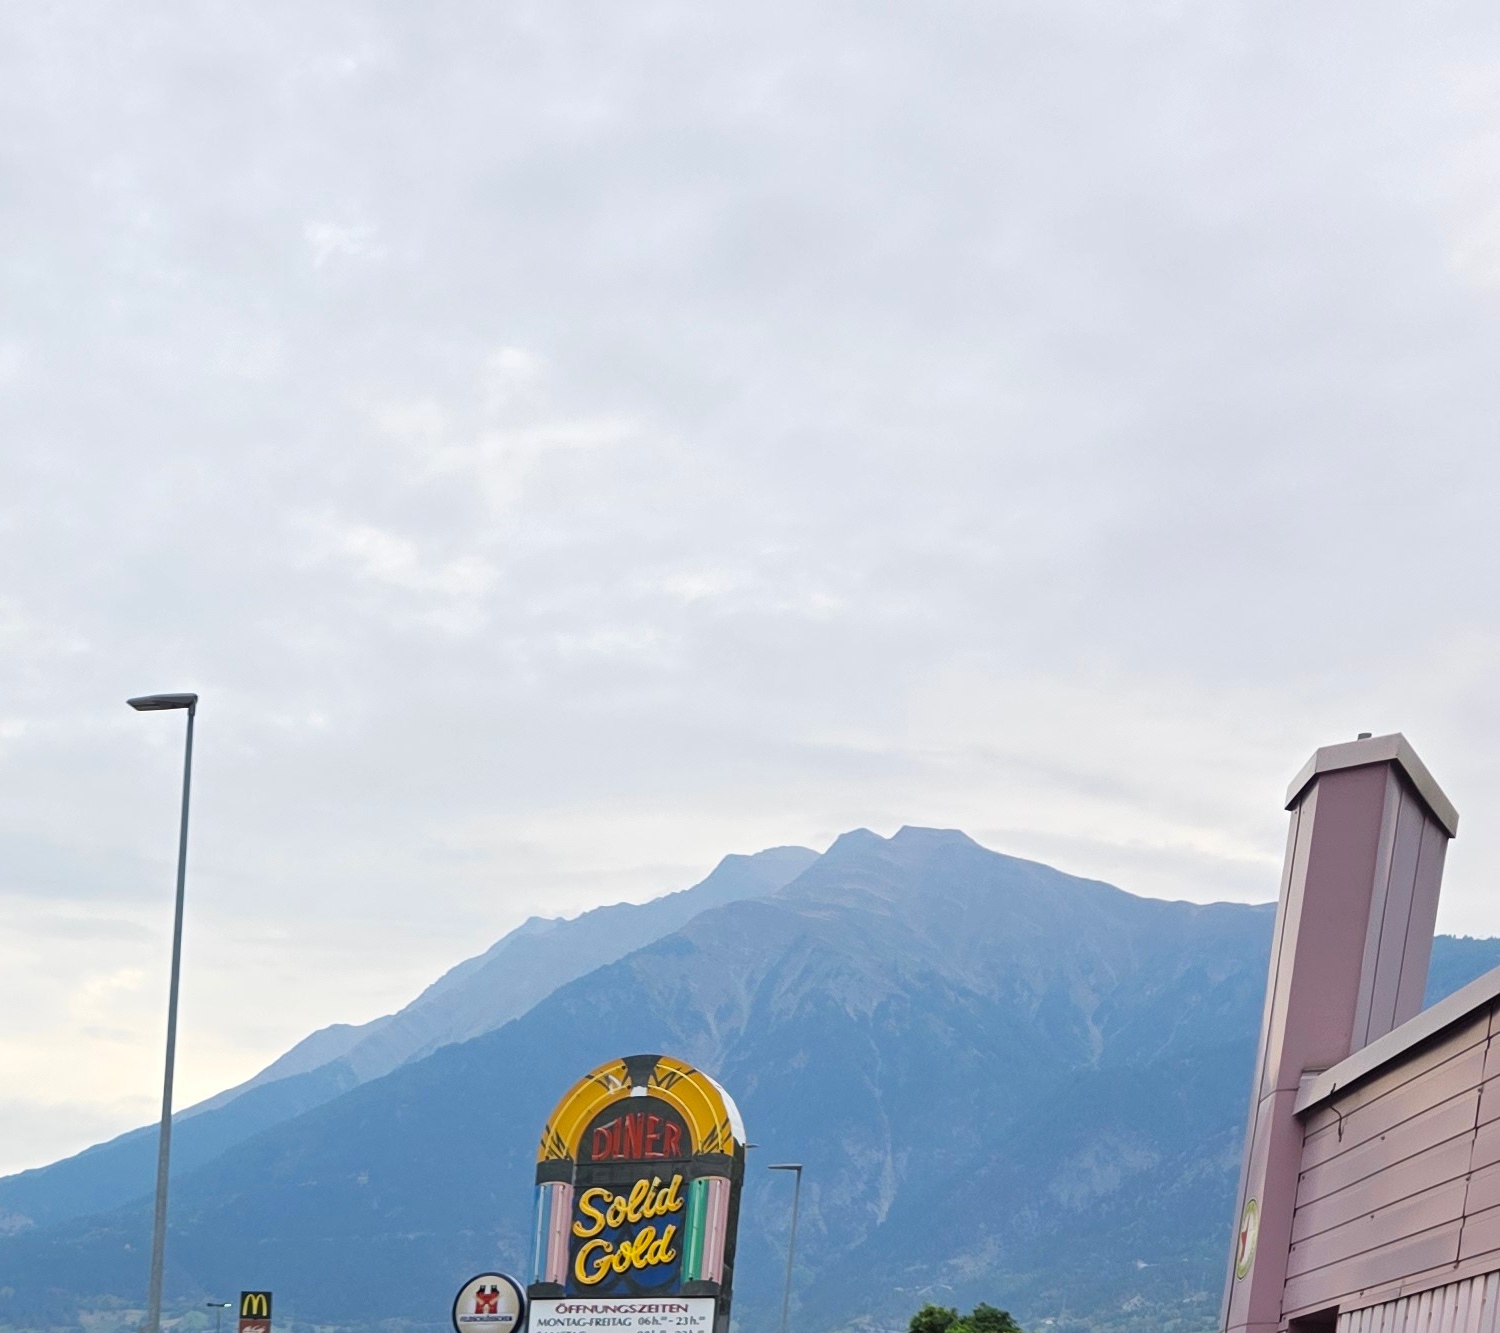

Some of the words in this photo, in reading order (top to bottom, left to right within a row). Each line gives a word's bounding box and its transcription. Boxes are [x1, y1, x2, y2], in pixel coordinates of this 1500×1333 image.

[592, 1112, 683, 1161] DINER
[572, 1174, 684, 1238] Solid
[574, 1224, 676, 1285] Gold
[537, 1317, 632, 1327] MONTAG-FREITAG
[555, 1303, 689, 1314] ÖFFNUNGSZEITEN
